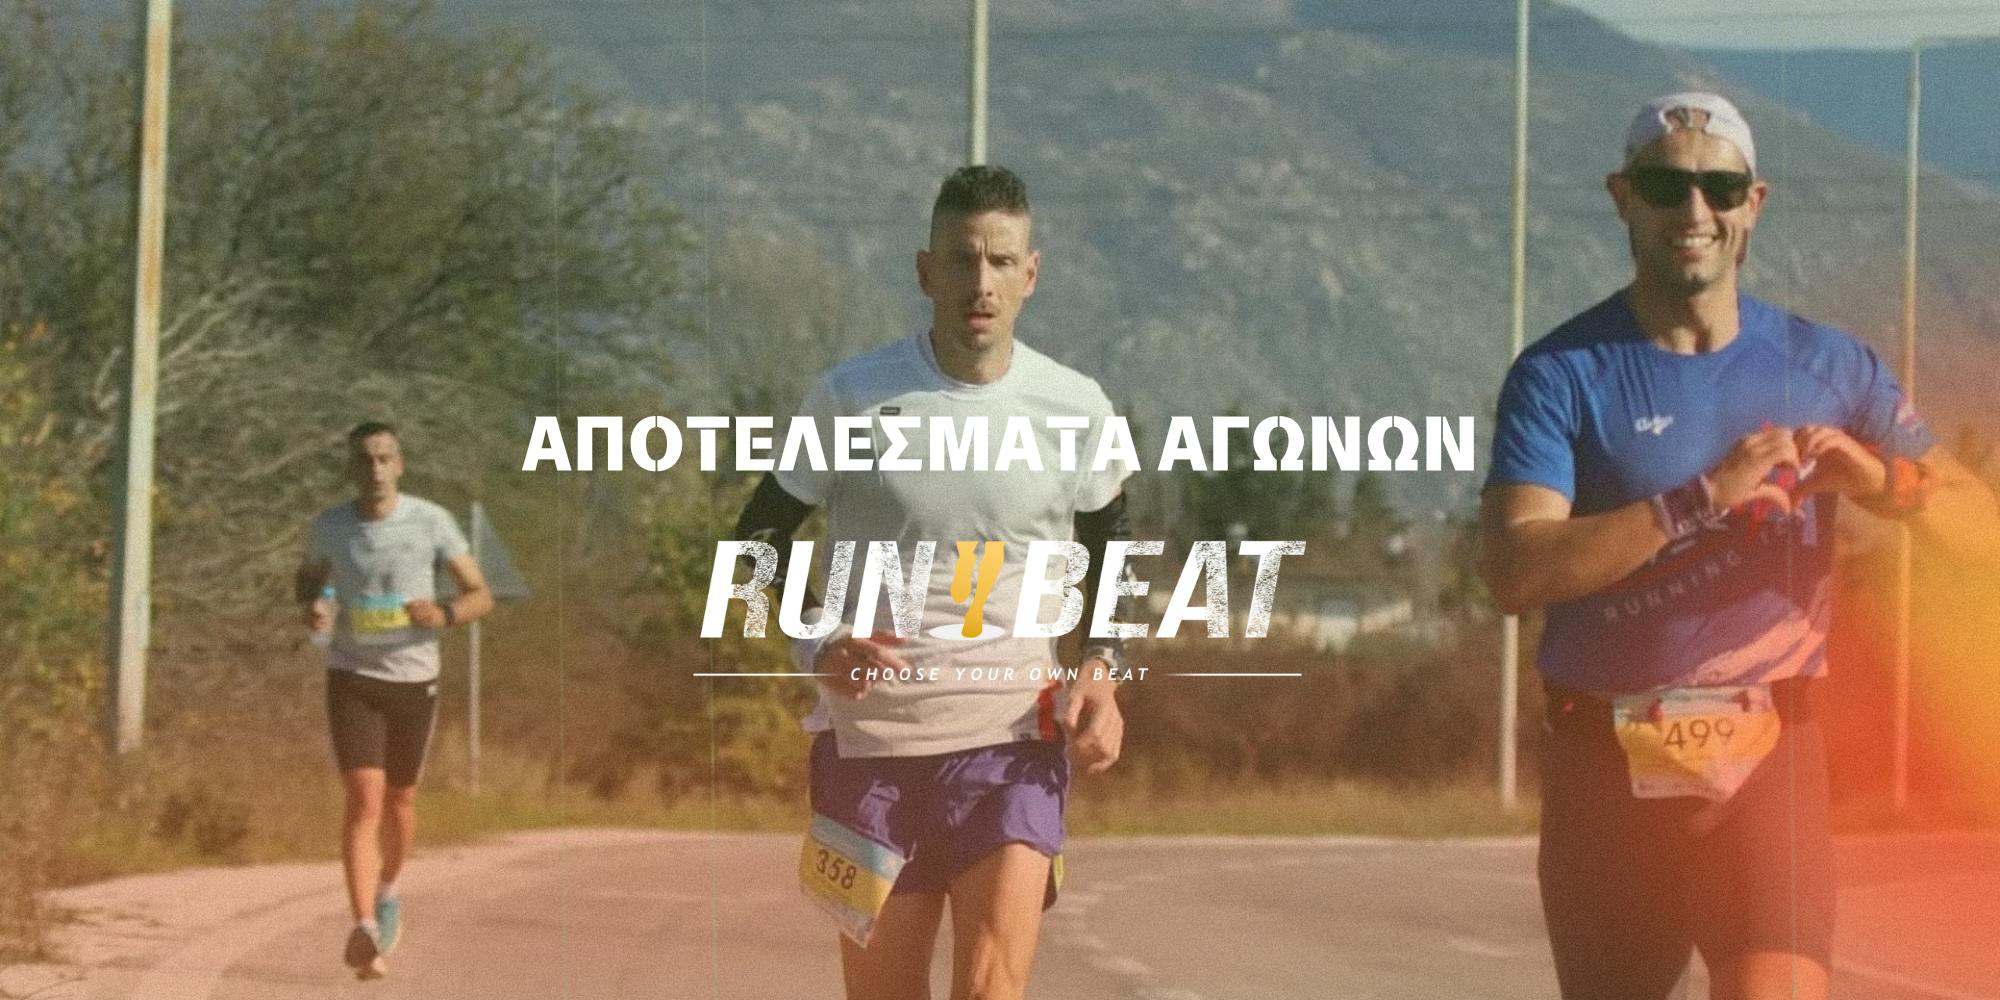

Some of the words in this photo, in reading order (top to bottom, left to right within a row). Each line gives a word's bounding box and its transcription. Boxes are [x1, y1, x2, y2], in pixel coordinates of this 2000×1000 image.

[1603, 550, 1741, 621] RUNNING
[1663, 718, 1735, 750] 499
[815, 848, 857, 890] 358
